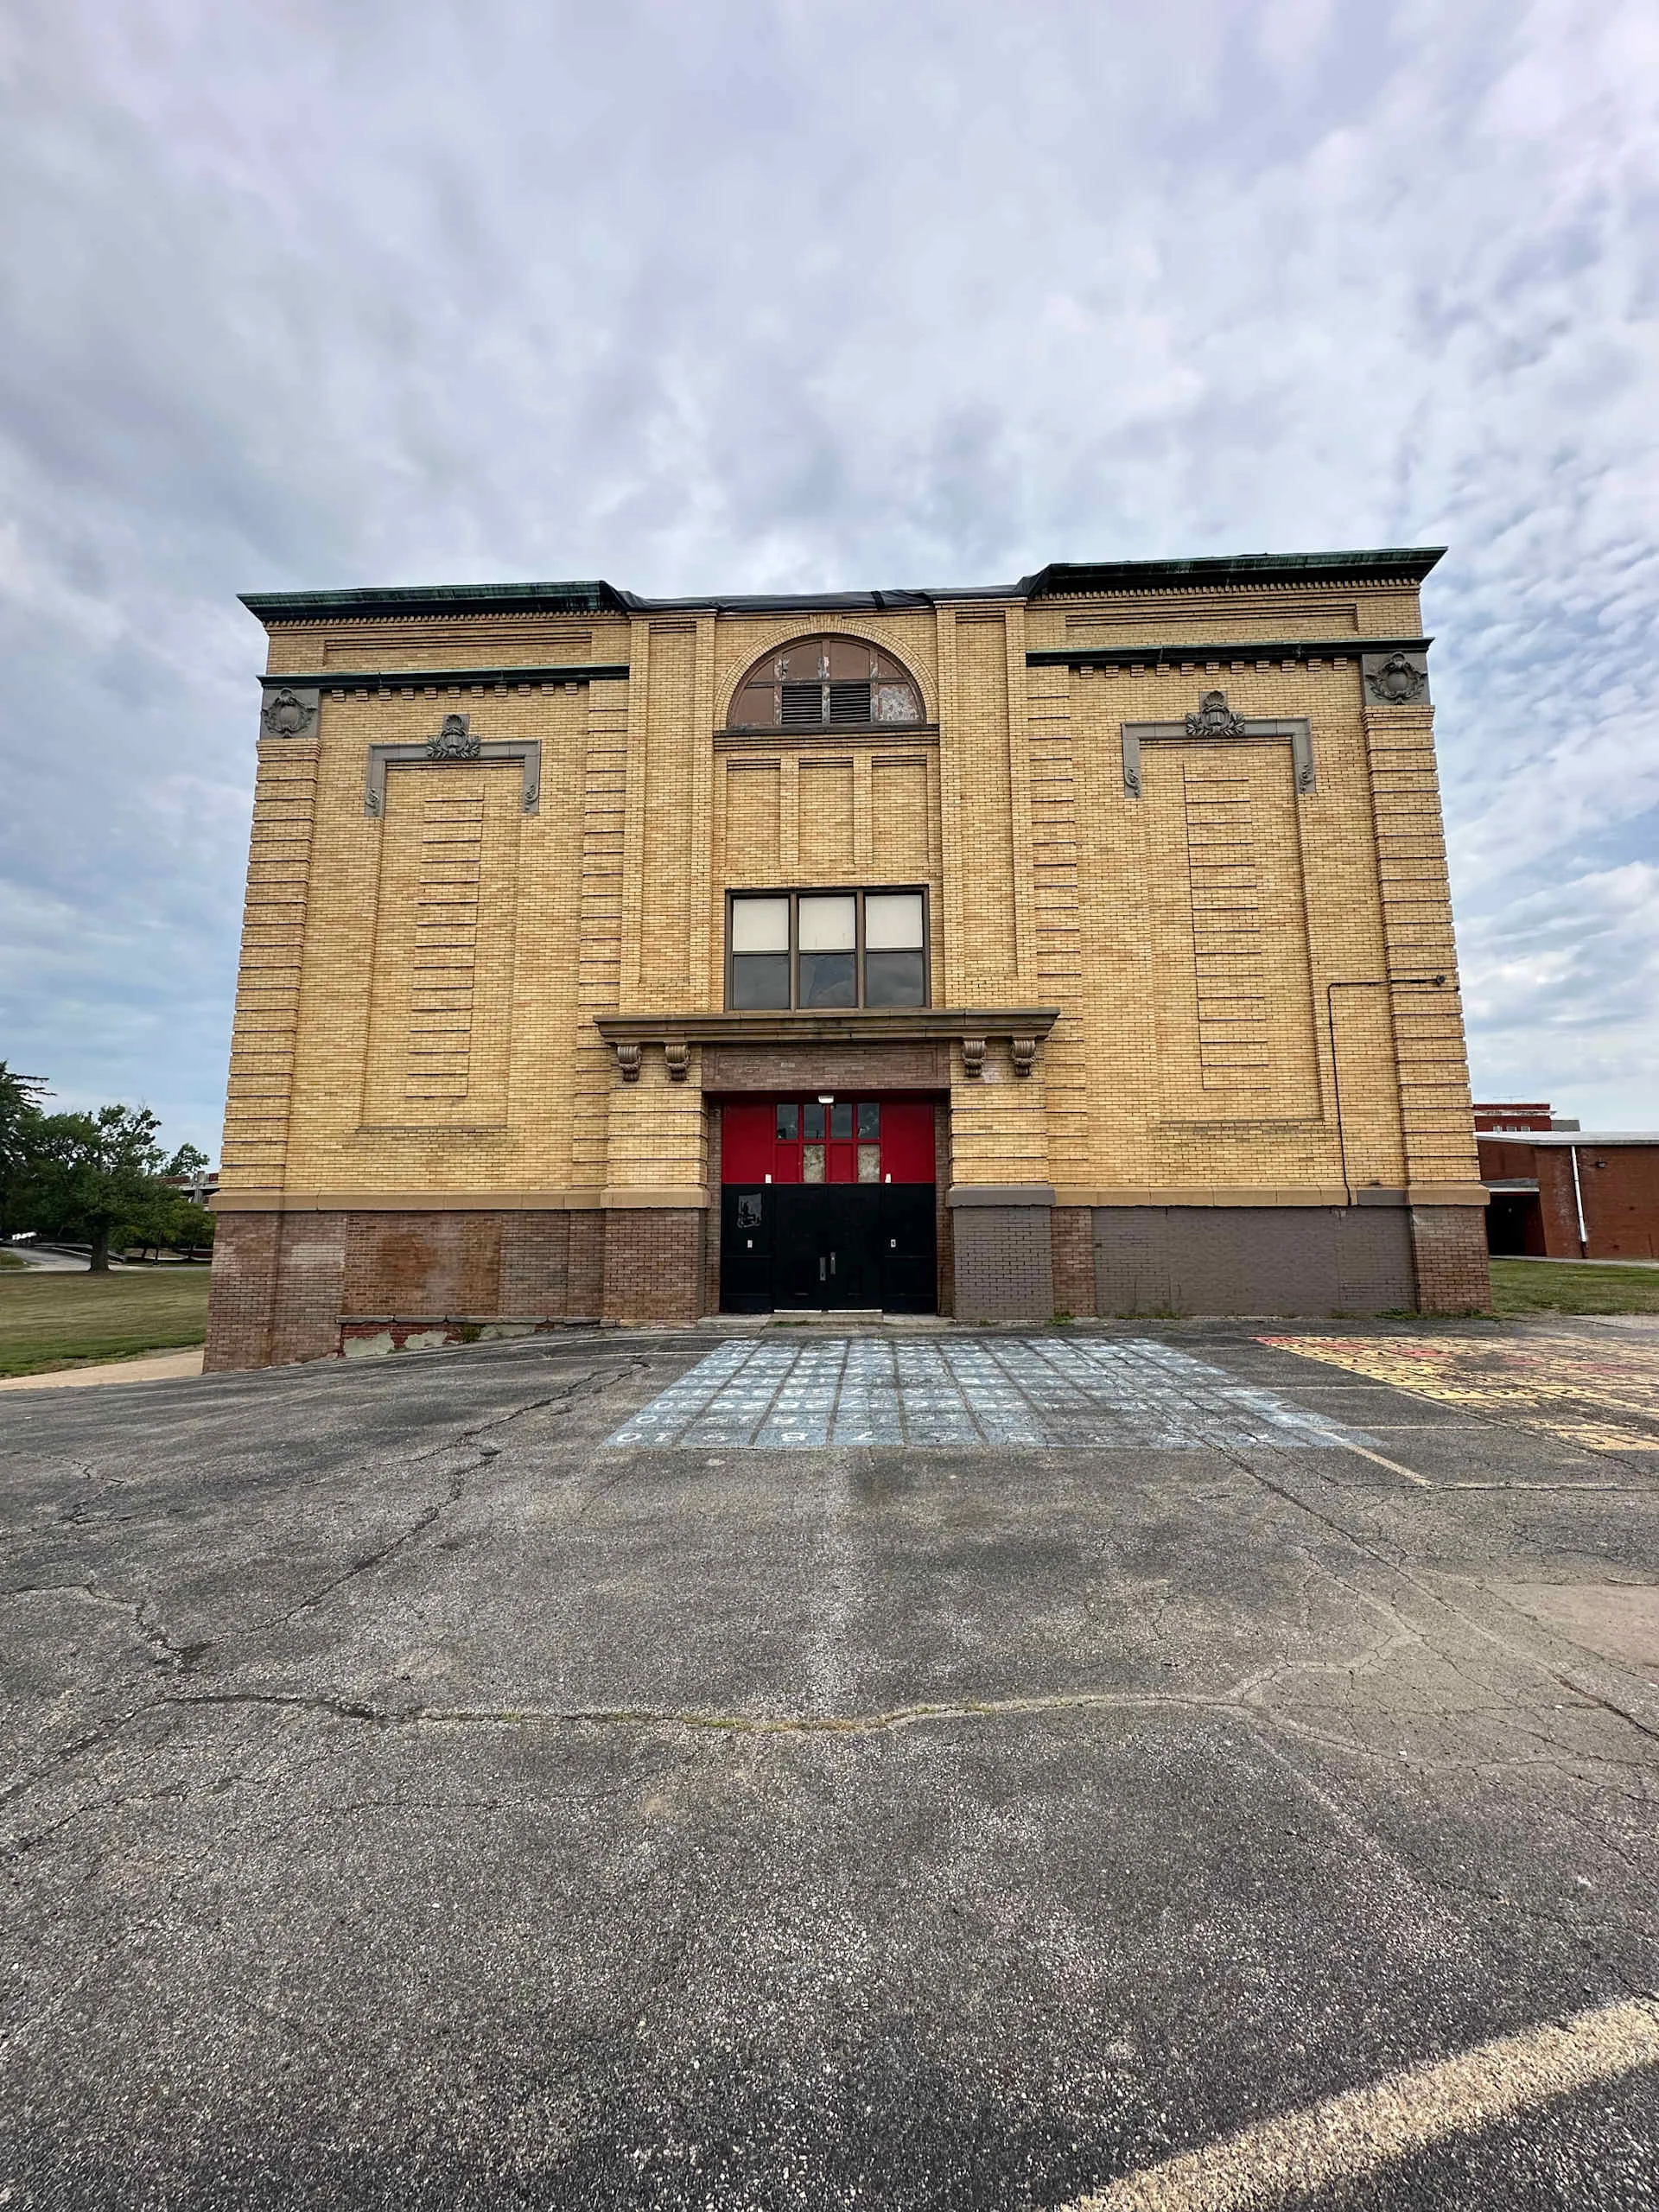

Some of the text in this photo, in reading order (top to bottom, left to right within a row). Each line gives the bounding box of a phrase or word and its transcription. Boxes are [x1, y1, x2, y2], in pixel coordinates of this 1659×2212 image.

[615, 1433, 671, 1443] 10
[782, 1433, 807, 1442] 8
[851, 1432, 876, 1440] 7
